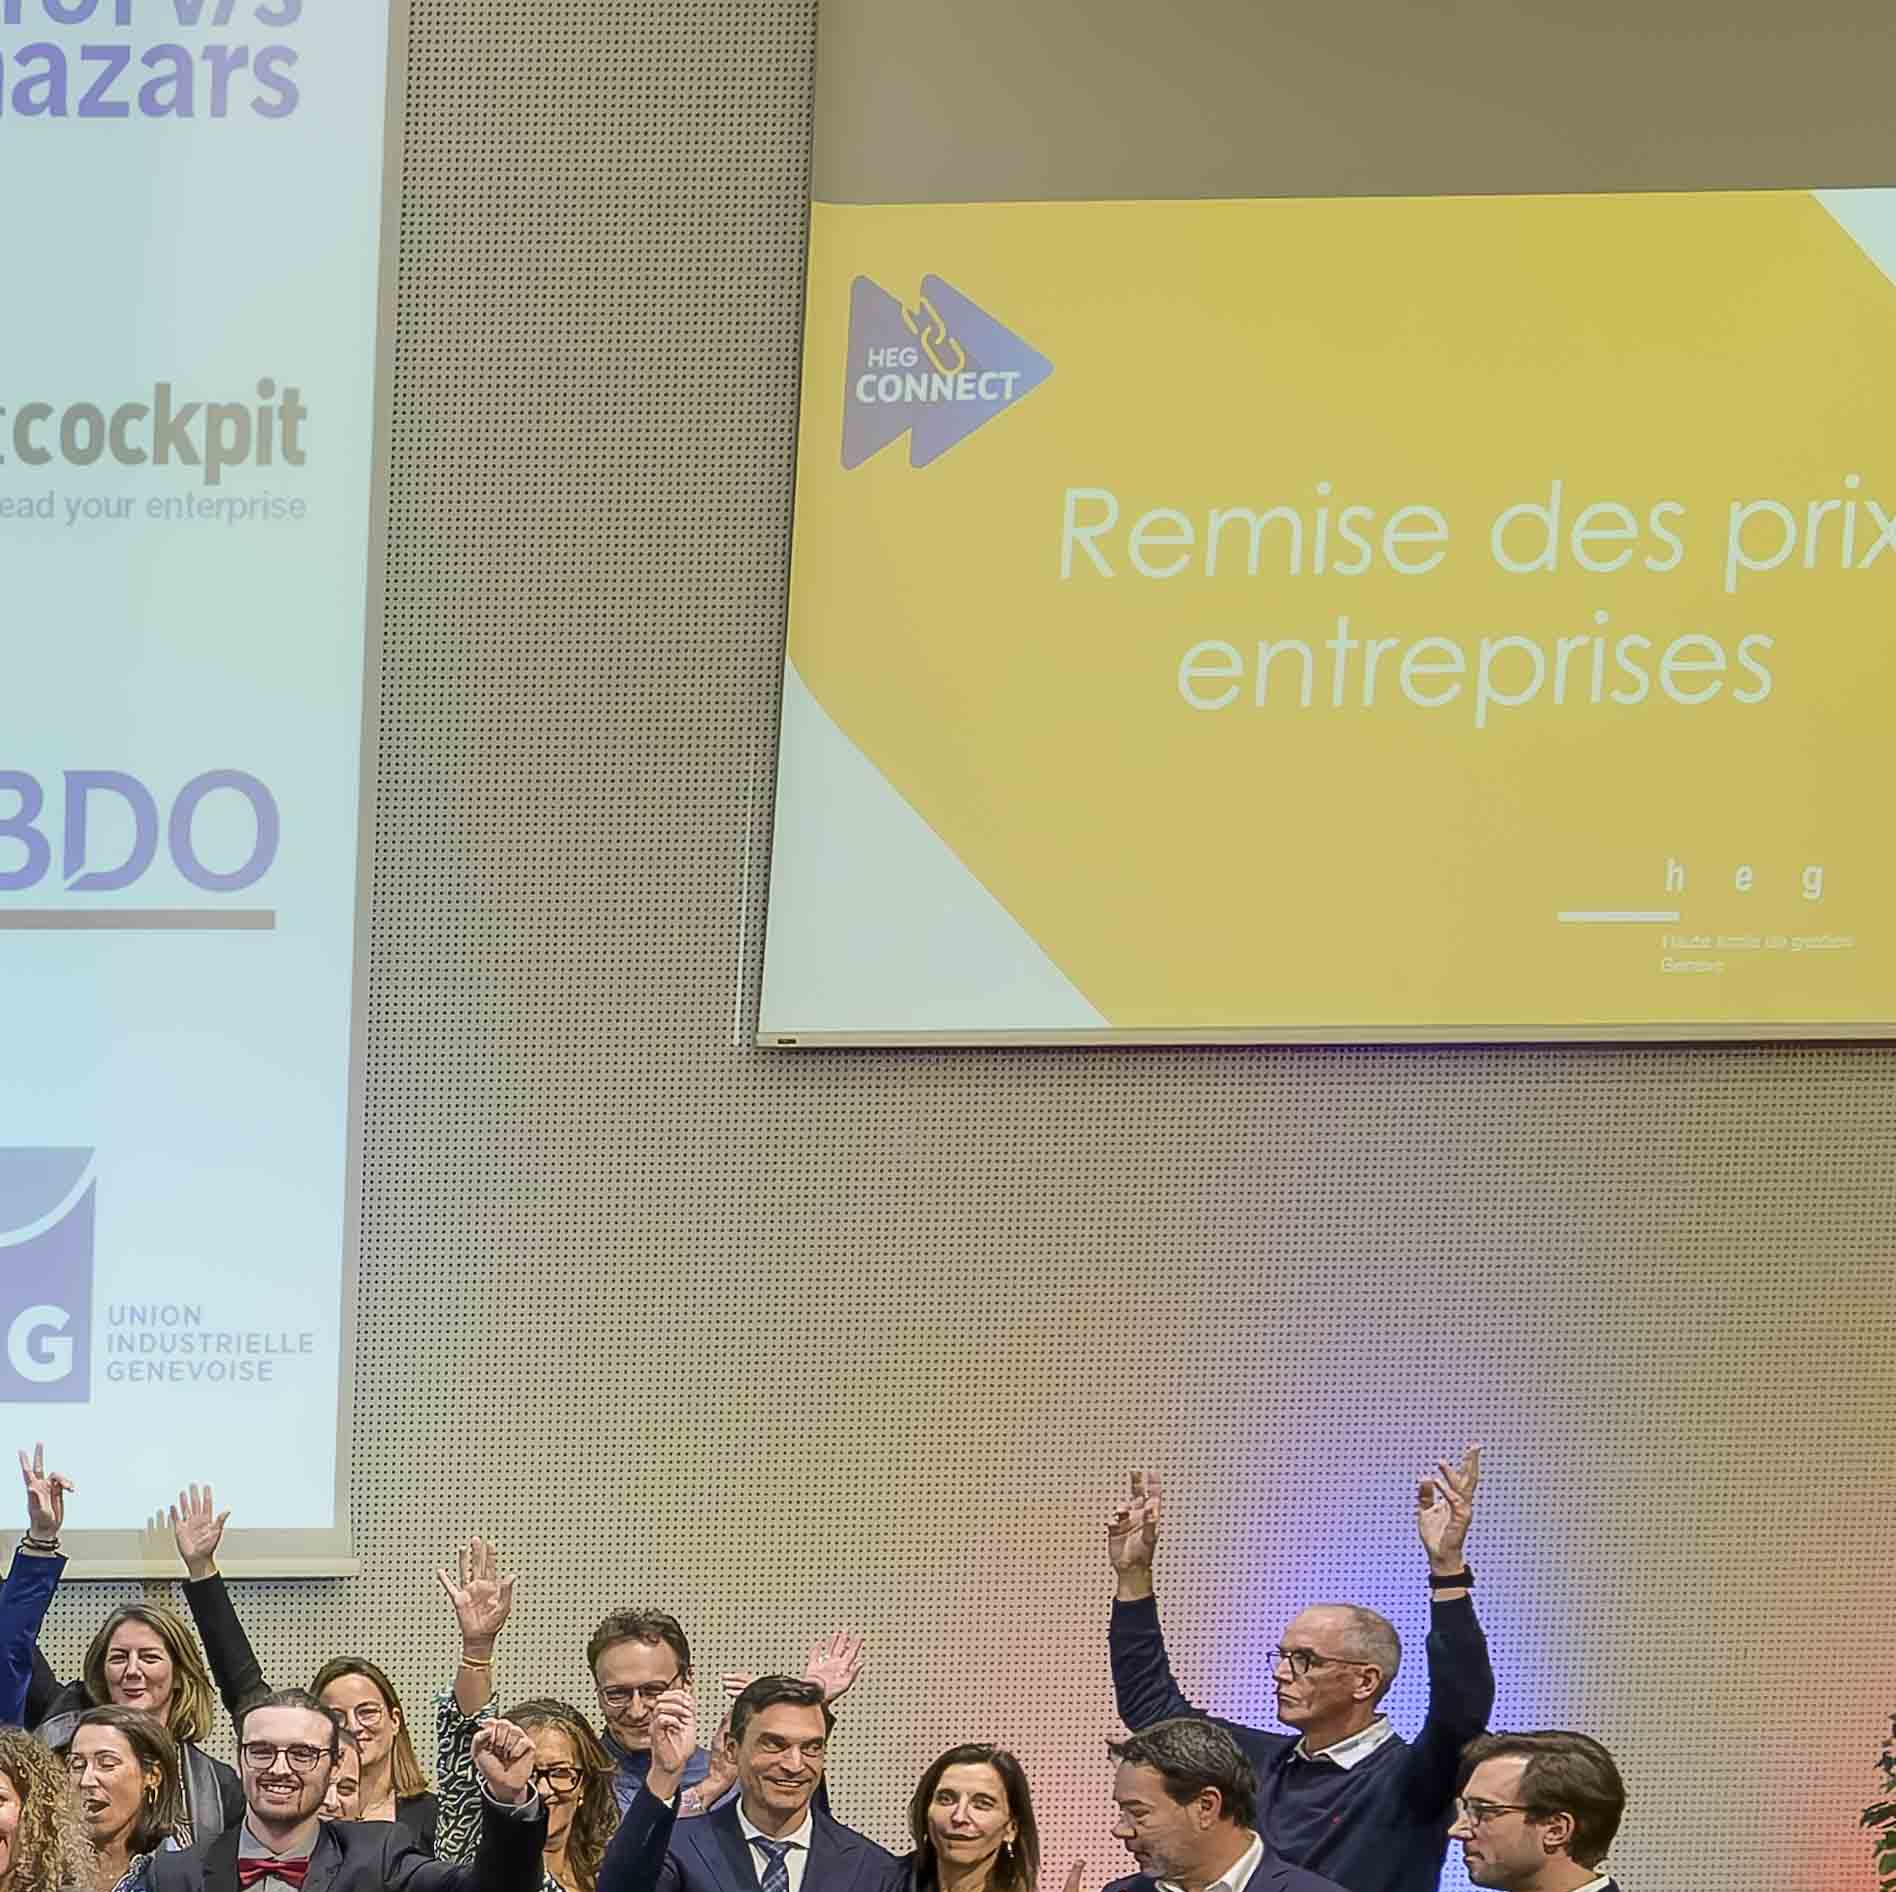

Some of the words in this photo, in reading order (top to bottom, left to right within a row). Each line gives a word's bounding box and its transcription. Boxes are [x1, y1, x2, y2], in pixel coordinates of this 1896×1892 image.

[867, 346, 919, 369] HEG
[856, 370, 1020, 403] CONNECT
[63, 494, 139, 530] your
[144, 489, 308, 532] enterprise
[1059, 482, 1450, 580] Remise
[1490, 479, 1686, 574] des
[1177, 610, 1774, 729] entreprises
[106, 1302, 204, 1330] UNION
[106, 1330, 315, 1356] INDUSTRIELLE
[106, 1357, 274, 1383] GENEVOISE
